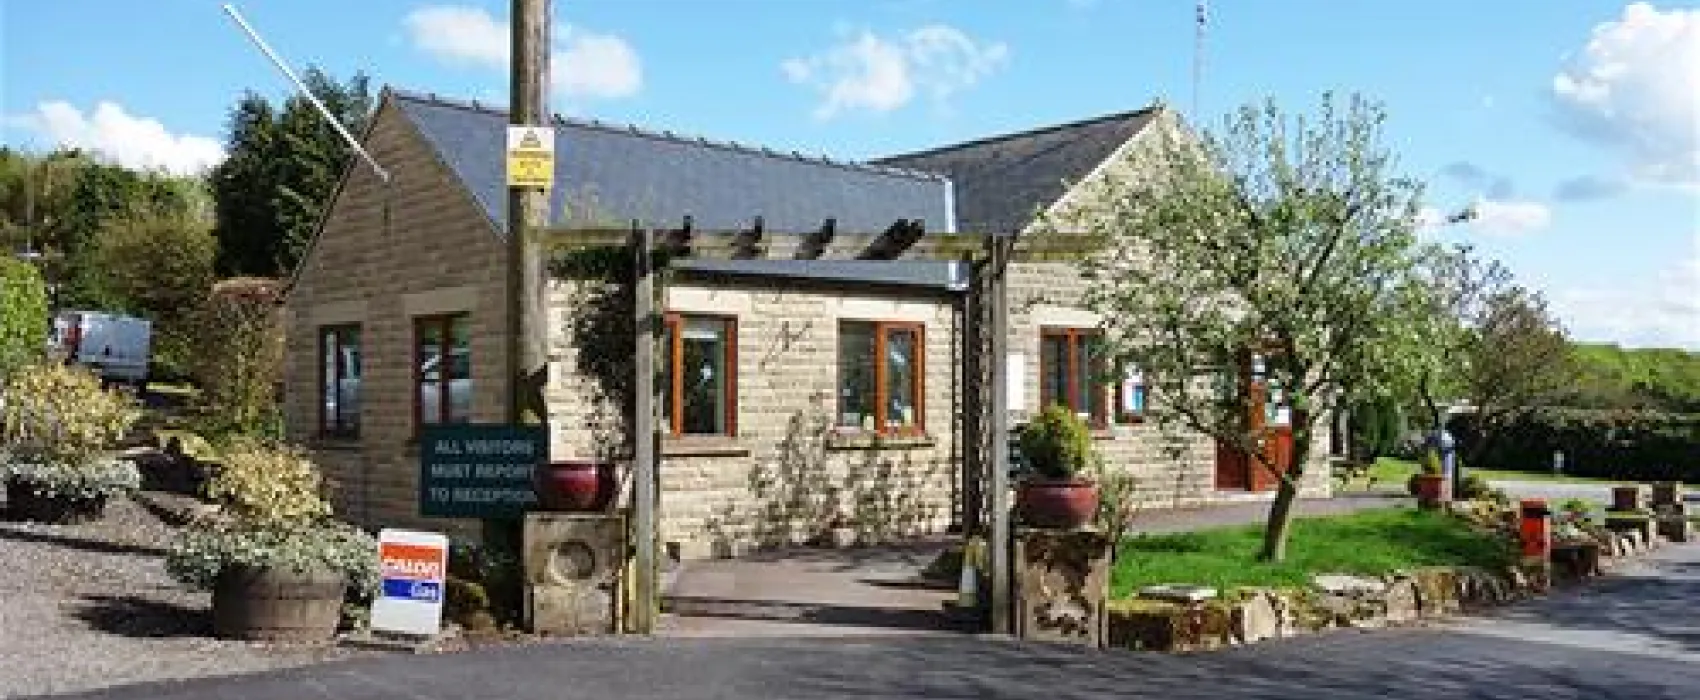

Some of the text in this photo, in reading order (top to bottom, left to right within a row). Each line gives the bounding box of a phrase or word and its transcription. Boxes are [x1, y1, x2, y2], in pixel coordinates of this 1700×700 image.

[434, 439, 535, 454] ALL VISITORS
[431, 463, 536, 478] MUST REPORT
[428, 487, 450, 502] TO
